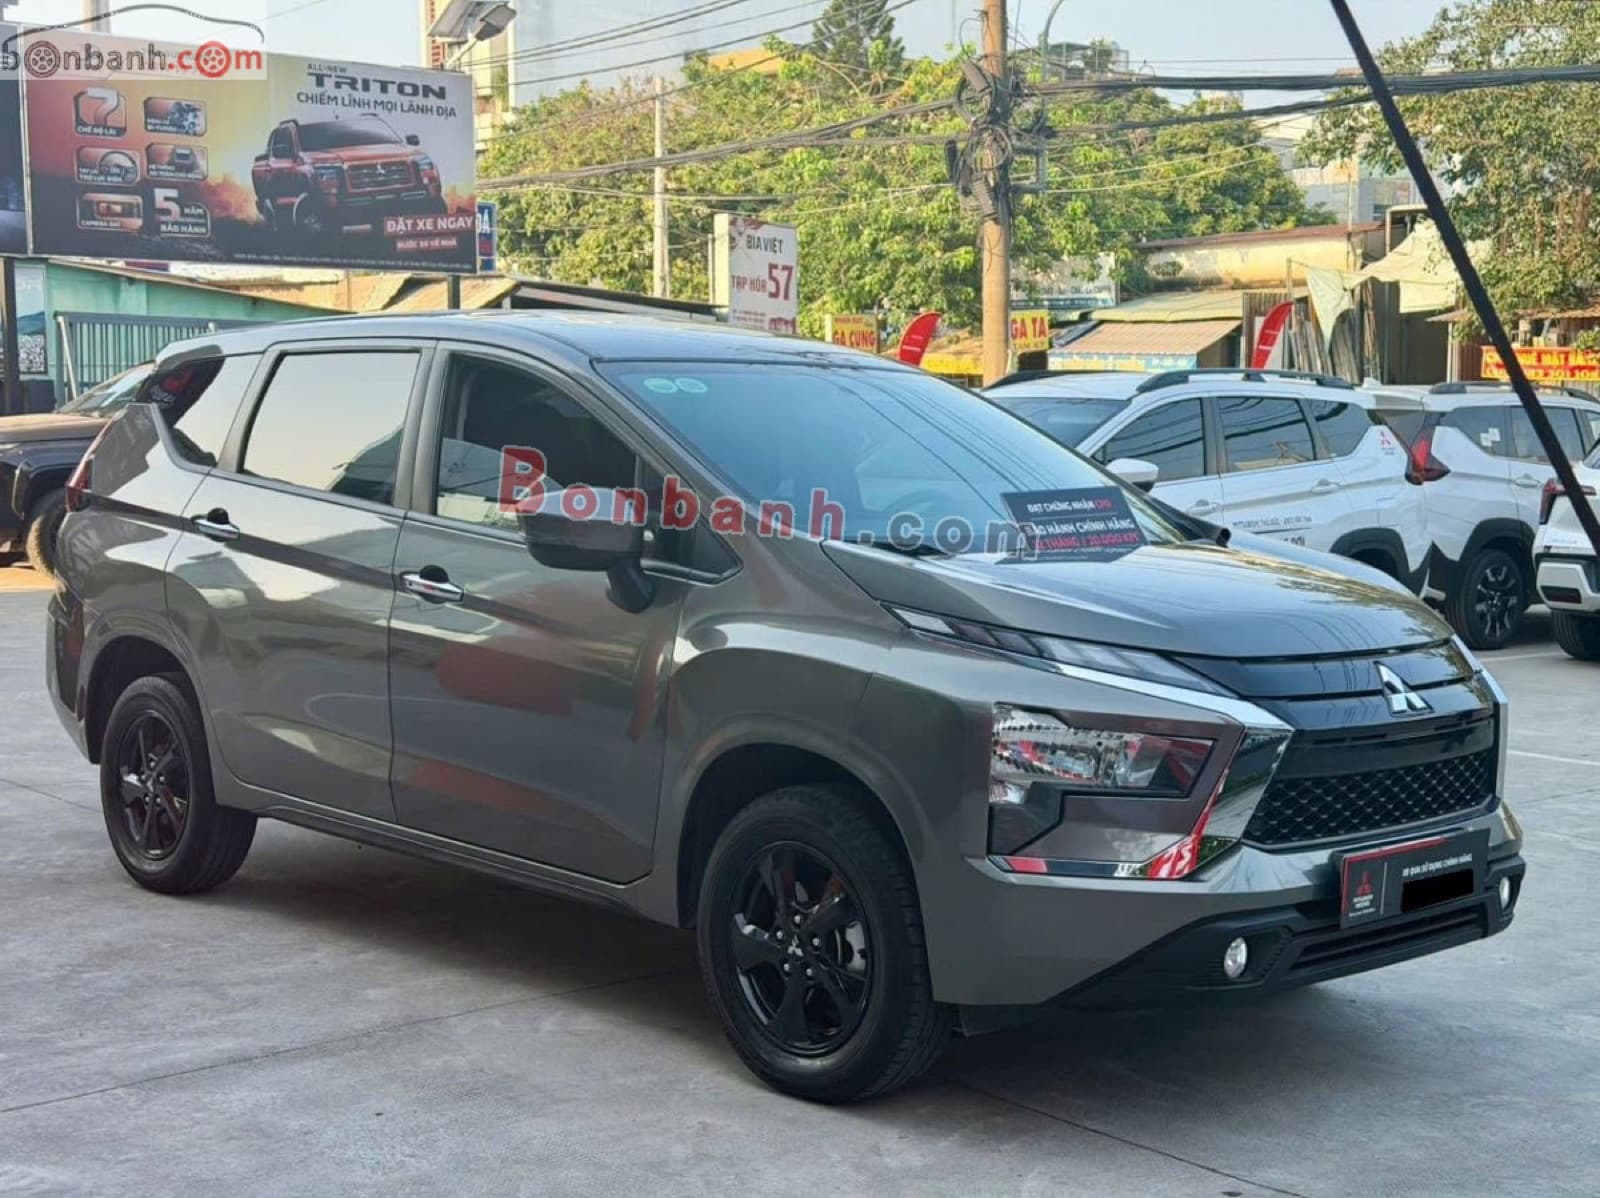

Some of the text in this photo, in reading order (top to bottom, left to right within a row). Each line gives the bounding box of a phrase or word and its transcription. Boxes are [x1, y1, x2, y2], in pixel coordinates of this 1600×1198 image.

[307, 63, 347, 74] ALL-NEW
[307, 72, 447, 100] TRITON
[86, 87, 119, 127] 7
[297, 90, 338, 107] CHIẾM
[374, 101, 397, 115] MỌI
[401, 101, 434, 117] LÃNH
[436, 106, 457, 120] ĐỊA
[154, 188, 180, 222] 5
[387, 216, 474, 234] ĐẶT XE NGAY
[746, 234, 784, 255] BIA VIỆT
[768, 263, 794, 300] 57
